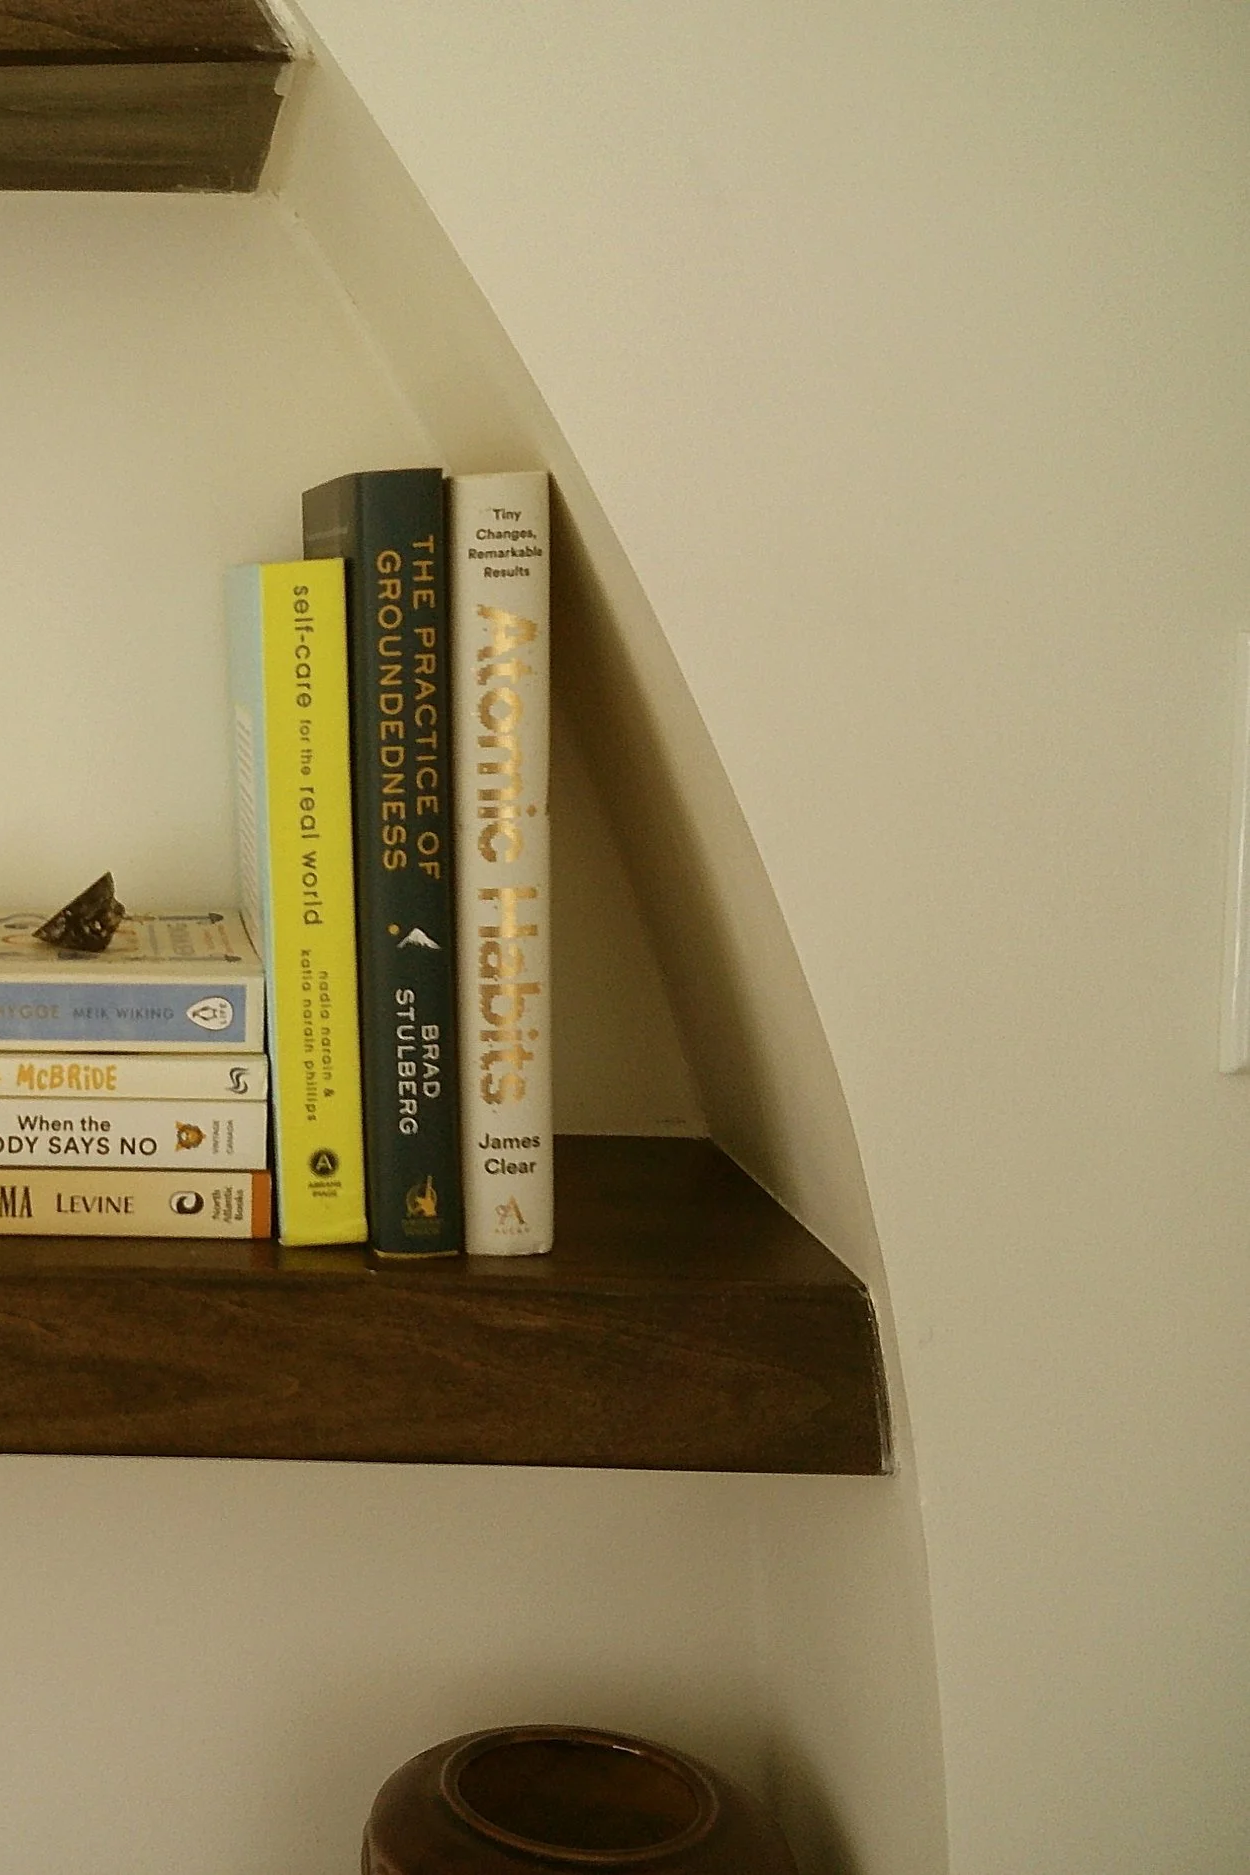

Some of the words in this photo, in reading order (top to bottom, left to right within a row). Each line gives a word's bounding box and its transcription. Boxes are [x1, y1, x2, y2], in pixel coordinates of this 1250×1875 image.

[476, 528, 537, 541] Changes,
[493, 508, 522, 521] Tiny
[412, 535, 435, 610] THE
[468, 546, 543, 559] Remarkable
[483, 566, 531, 578] Results
[293, 584, 314, 708] self-care
[300, 719, 311, 743] for
[376, 548, 407, 872] GROUNDEDNESS
[414, 627, 439, 816] PRACTICE
[477, 603, 539, 864] Atomic
[300, 749, 315, 776] the
[300, 787, 319, 839] real
[417, 830, 442, 880] OF
[301, 850, 323, 925] world
[300, 949, 312, 991] katia
[319, 970, 332, 1019] nadia
[72, 1006, 111, 1020] MEIK
[116, 1006, 175, 1021] WIKING
[477, 887, 543, 1107] Habits
[303, 999, 316, 1053] narain
[320, 1027, 333, 1081] narain
[396, 987, 420, 1136] STULBERG
[421, 1024, 441, 1098] BRAD
[303, 1060, 318, 1122] phillips
[323, 1088, 335, 1098] &
[18, 1115, 73, 1132] When
[81, 1115, 111, 1132] the
[48, 1136, 110, 1155] SAYS
[119, 1136, 158, 1156] NO
[478, 1132, 541, 1150] James
[484, 1158, 537, 1175] Clear
[56, 1192, 135, 1214] LEVINE
